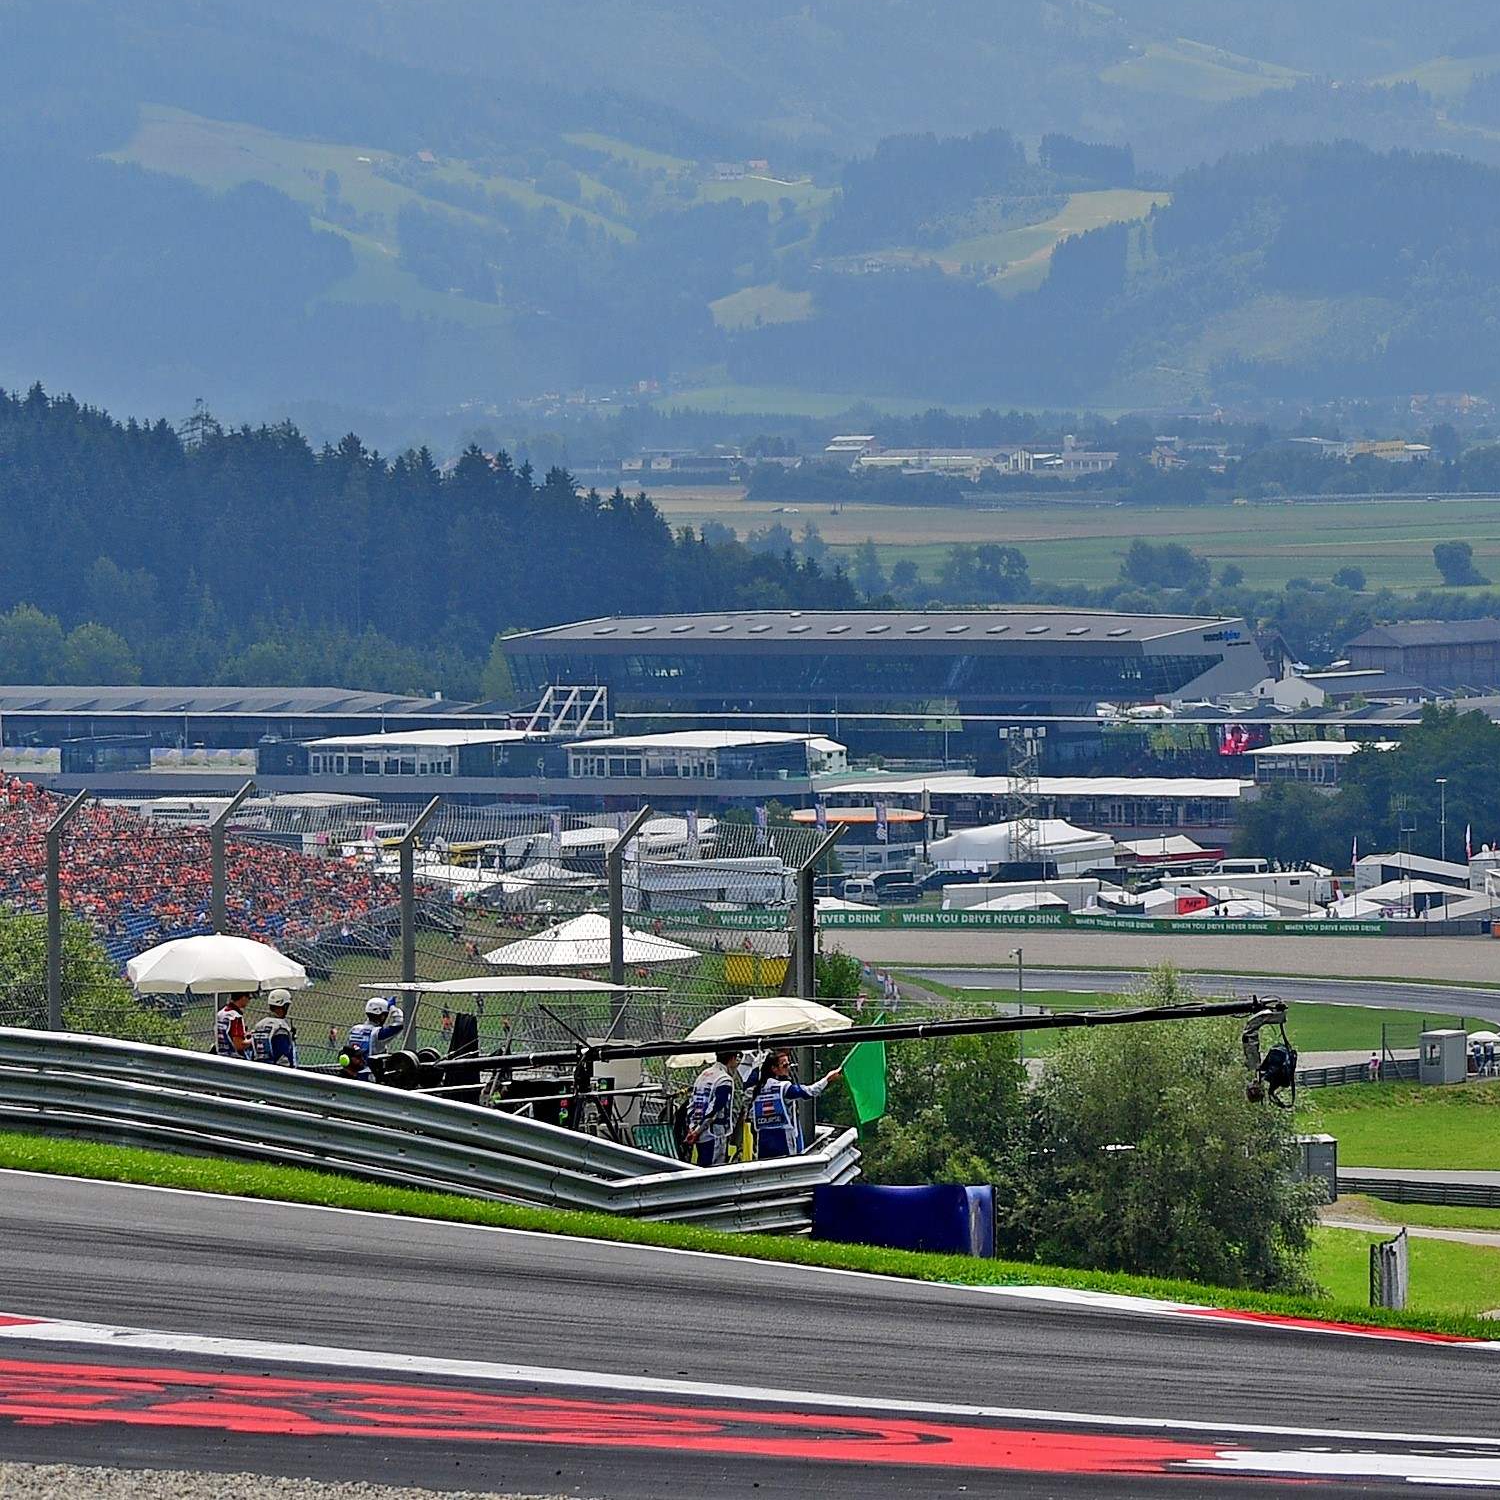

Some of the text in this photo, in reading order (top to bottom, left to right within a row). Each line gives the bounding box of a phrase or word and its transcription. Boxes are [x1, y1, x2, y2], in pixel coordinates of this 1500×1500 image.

[286, 755, 293, 766] 5
[537, 758, 544, 769] 6
[746, 760, 753, 771] 7
[721, 915, 752, 925] WHEN
[755, 915, 777, 925] YOU
[848, 914, 881, 924] DRINK
[903, 914, 1061, 925] WHEN YOU DRIVE NEVER DRINK
